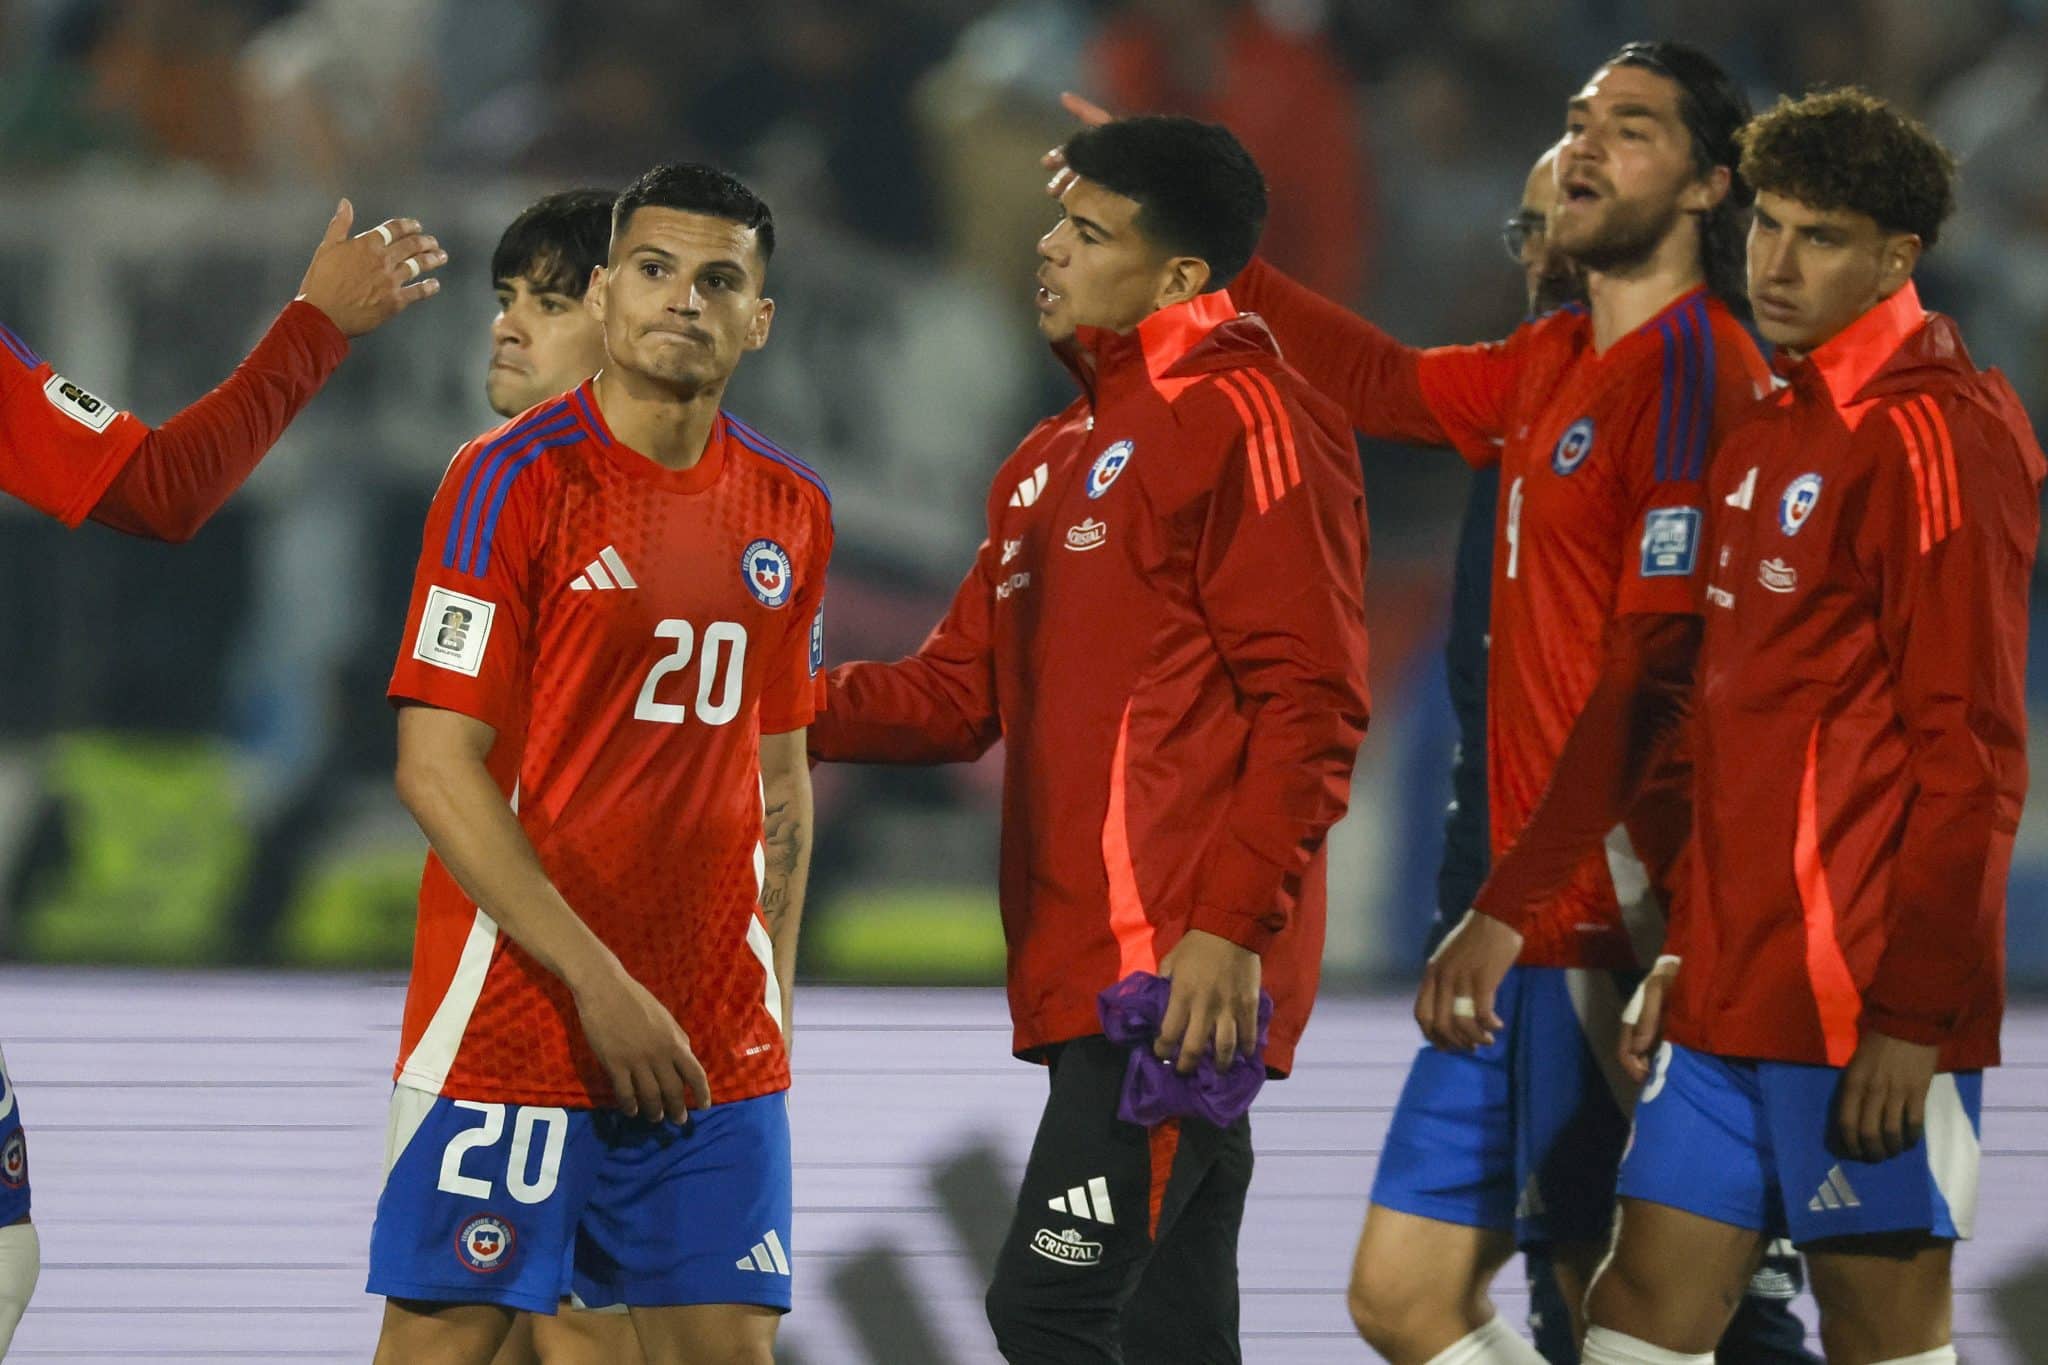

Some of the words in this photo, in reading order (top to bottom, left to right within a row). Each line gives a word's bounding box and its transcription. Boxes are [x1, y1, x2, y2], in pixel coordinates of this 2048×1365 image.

[634, 619, 747, 725] 20
[437, 1100, 569, 1205] 20
[1038, 1235, 1096, 1260] CRISTAL
